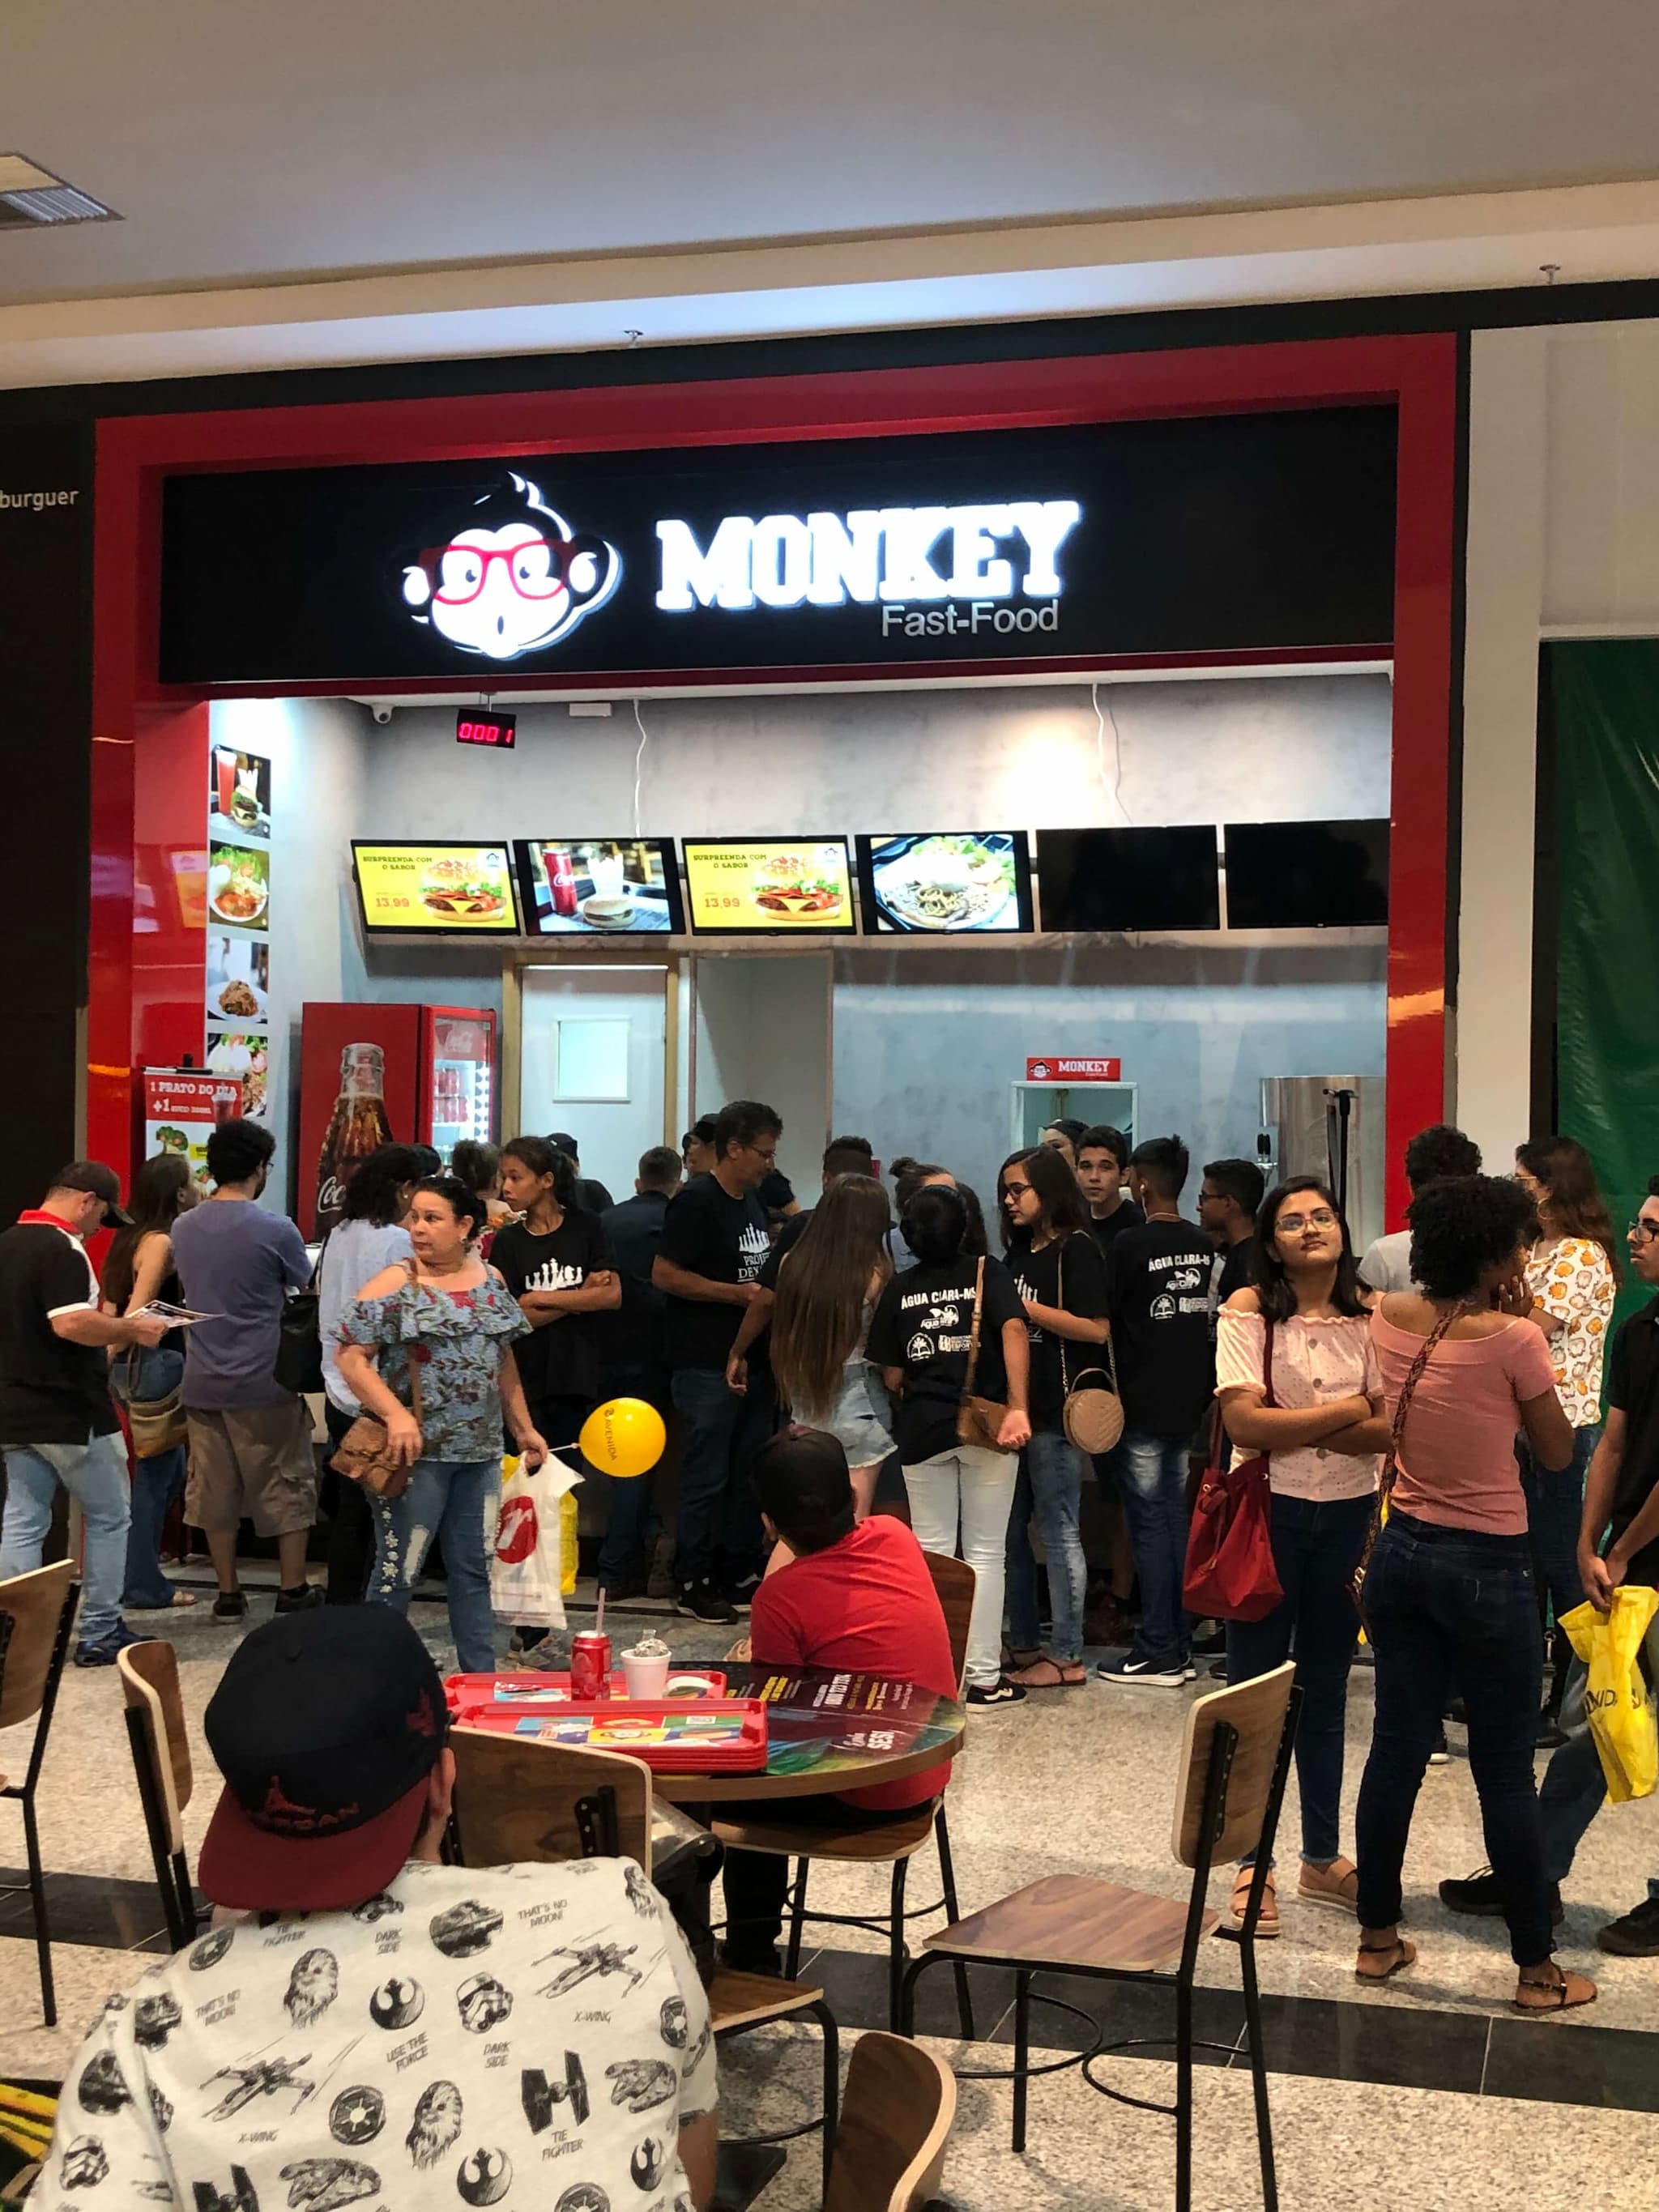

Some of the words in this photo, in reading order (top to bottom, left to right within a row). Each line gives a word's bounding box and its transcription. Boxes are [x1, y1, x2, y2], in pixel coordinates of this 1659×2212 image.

[0, 490, 79, 511] burguer
[655, 501, 1080, 610] MONKEY
[882, 600, 1059, 637] Fast-Food
[458, 722, 514, 743] 0001
[1058, 1060, 1110, 1072] MONKEY
[149, 1081, 156, 1093] 1
[159, 1081, 196, 1094] PRATO
[198, 1084, 214, 1095] DO
[1148, 1255, 1174, 1272] ÁGUA
[901, 1292, 930, 1310] ÁGUA
[867, 1730, 895, 1750] SESI
[518, 1901, 551, 1920] THAT'S
[553, 1899, 568, 1909] NO
[574, 2009, 614, 2025] X-WING
[386, 2044, 406, 2062] USE
[406, 2031, 429, 2049] THE
[483, 2040, 511, 2055] DARK
[396, 2045, 429, 2073] FORCE
[484, 2054, 509, 2069] SIDE
[551, 2129, 569, 2143] TIE
[542, 2137, 584, 2161] FIGHTER
